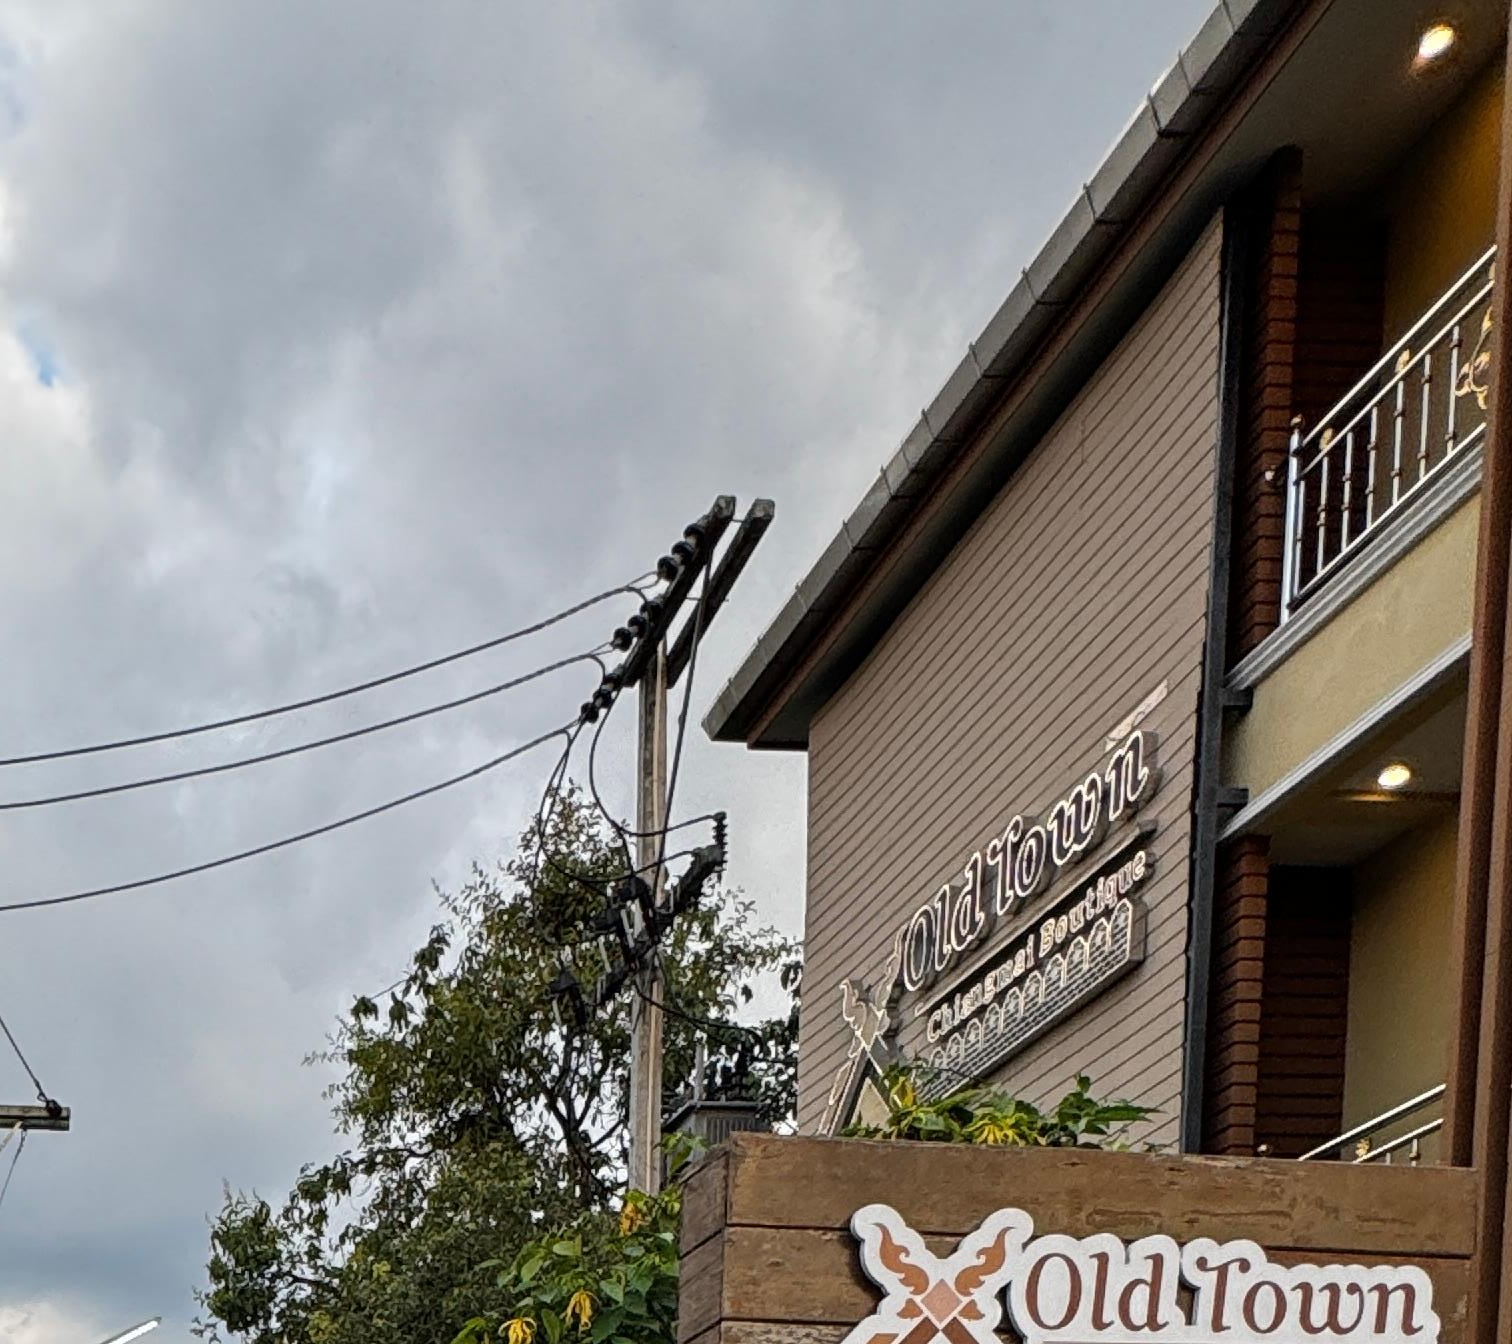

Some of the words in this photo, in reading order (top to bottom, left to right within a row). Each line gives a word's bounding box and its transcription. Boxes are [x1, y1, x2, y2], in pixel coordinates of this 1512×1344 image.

[903, 852, 984, 991] Old
[987, 730, 1150, 916] Town
[927, 935, 1035, 1043] Chiangmai
[1038, 851, 1147, 959] Boutique
[1024, 1251, 1170, 1332] Old
[1195, 1256, 1424, 1336] Town
